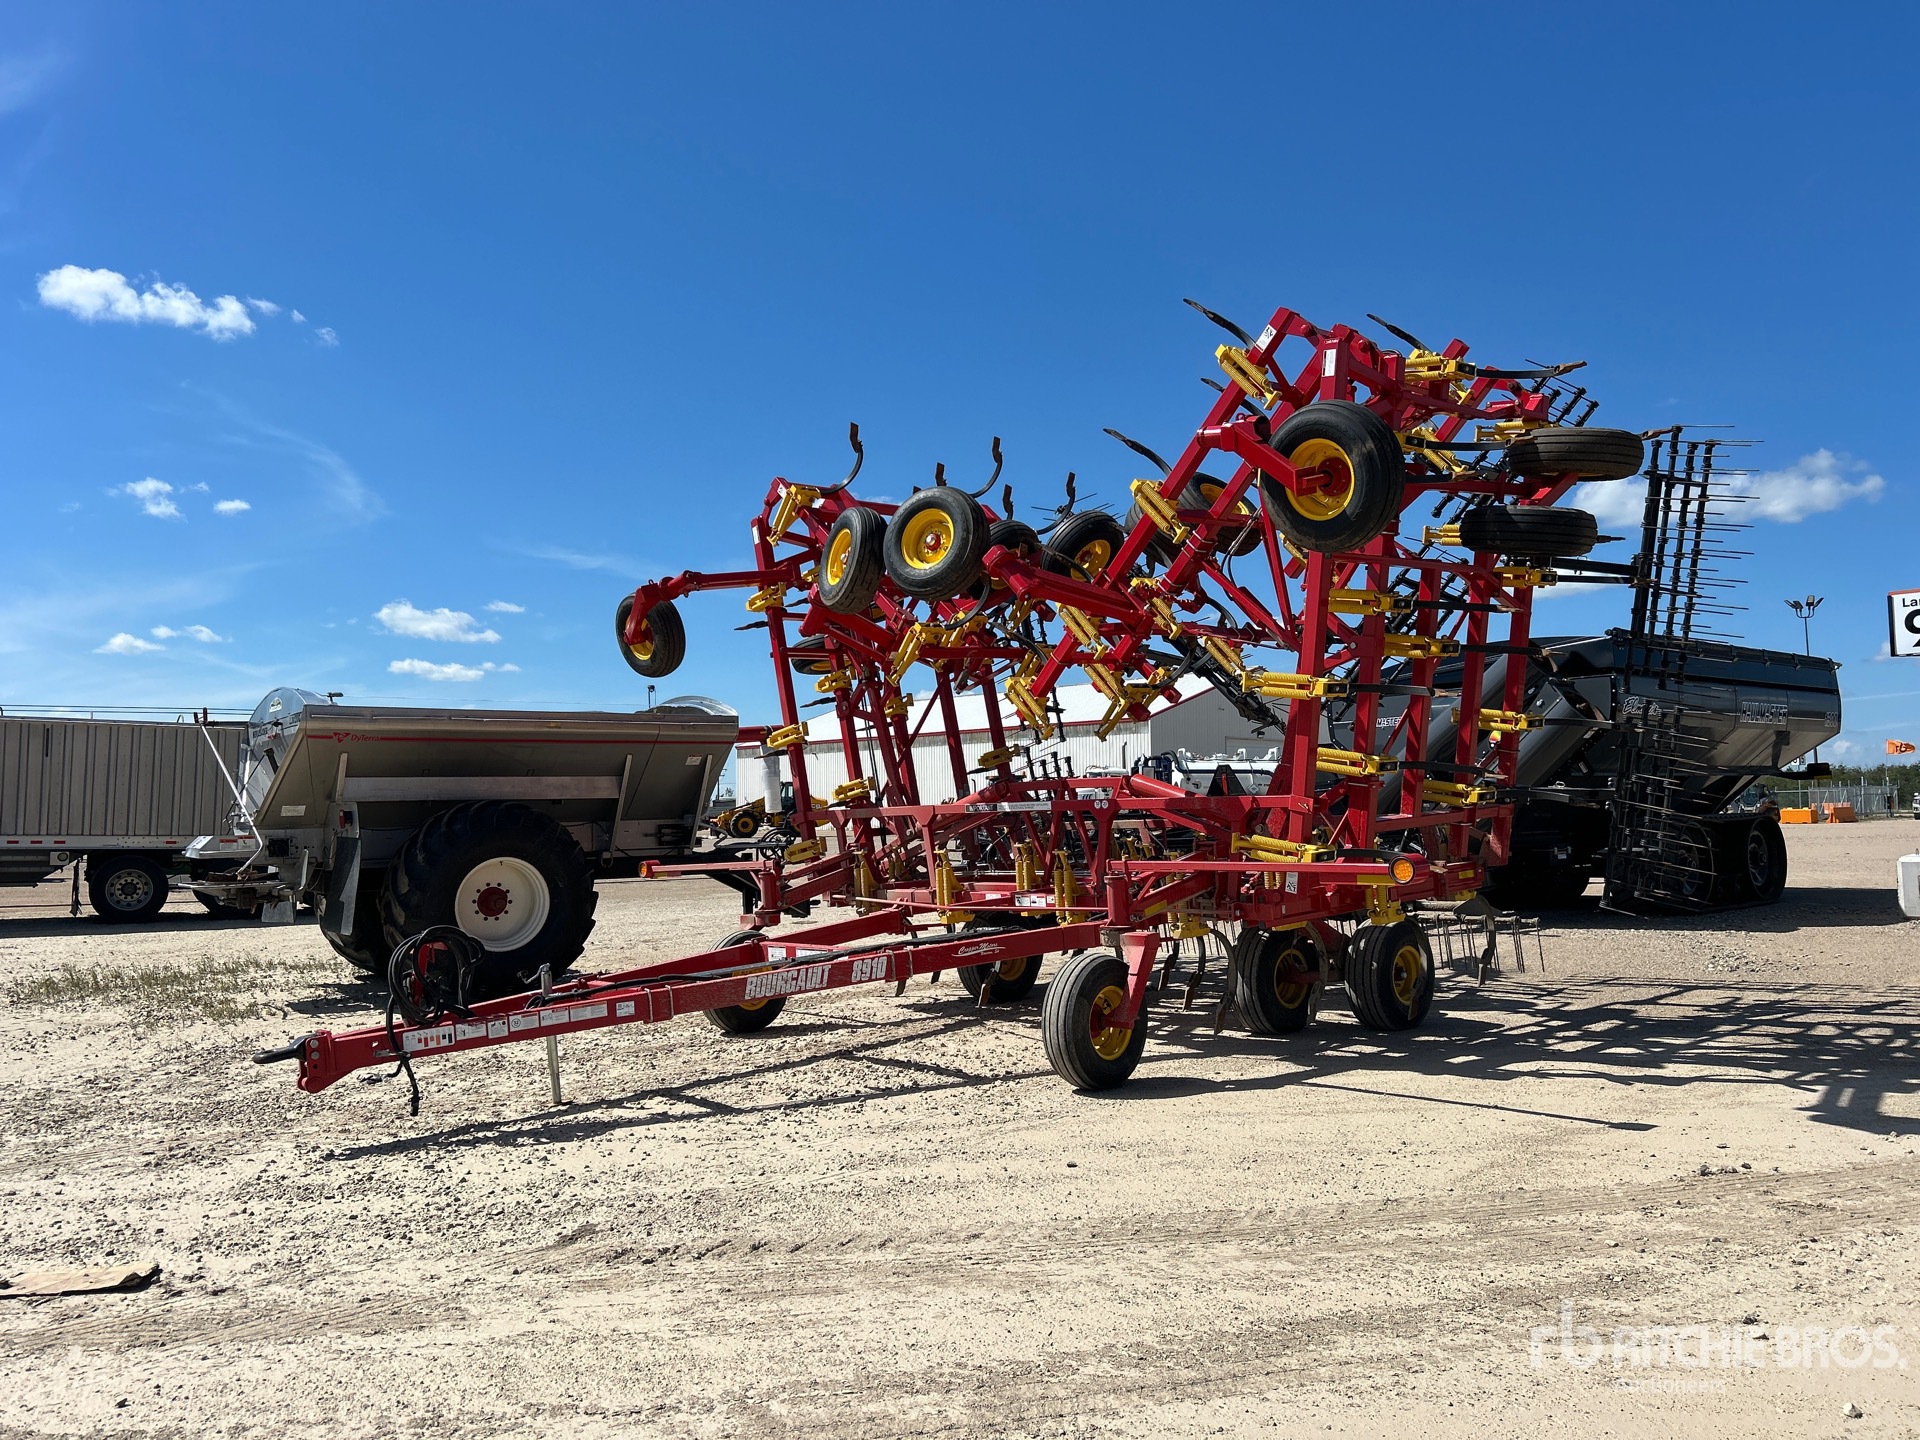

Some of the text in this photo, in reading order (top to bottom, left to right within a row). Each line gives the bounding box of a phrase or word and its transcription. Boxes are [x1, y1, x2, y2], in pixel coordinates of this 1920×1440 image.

[351, 733, 380, 742] DyTerra
[744, 956, 887, 1000] BOURGAULT 8910
